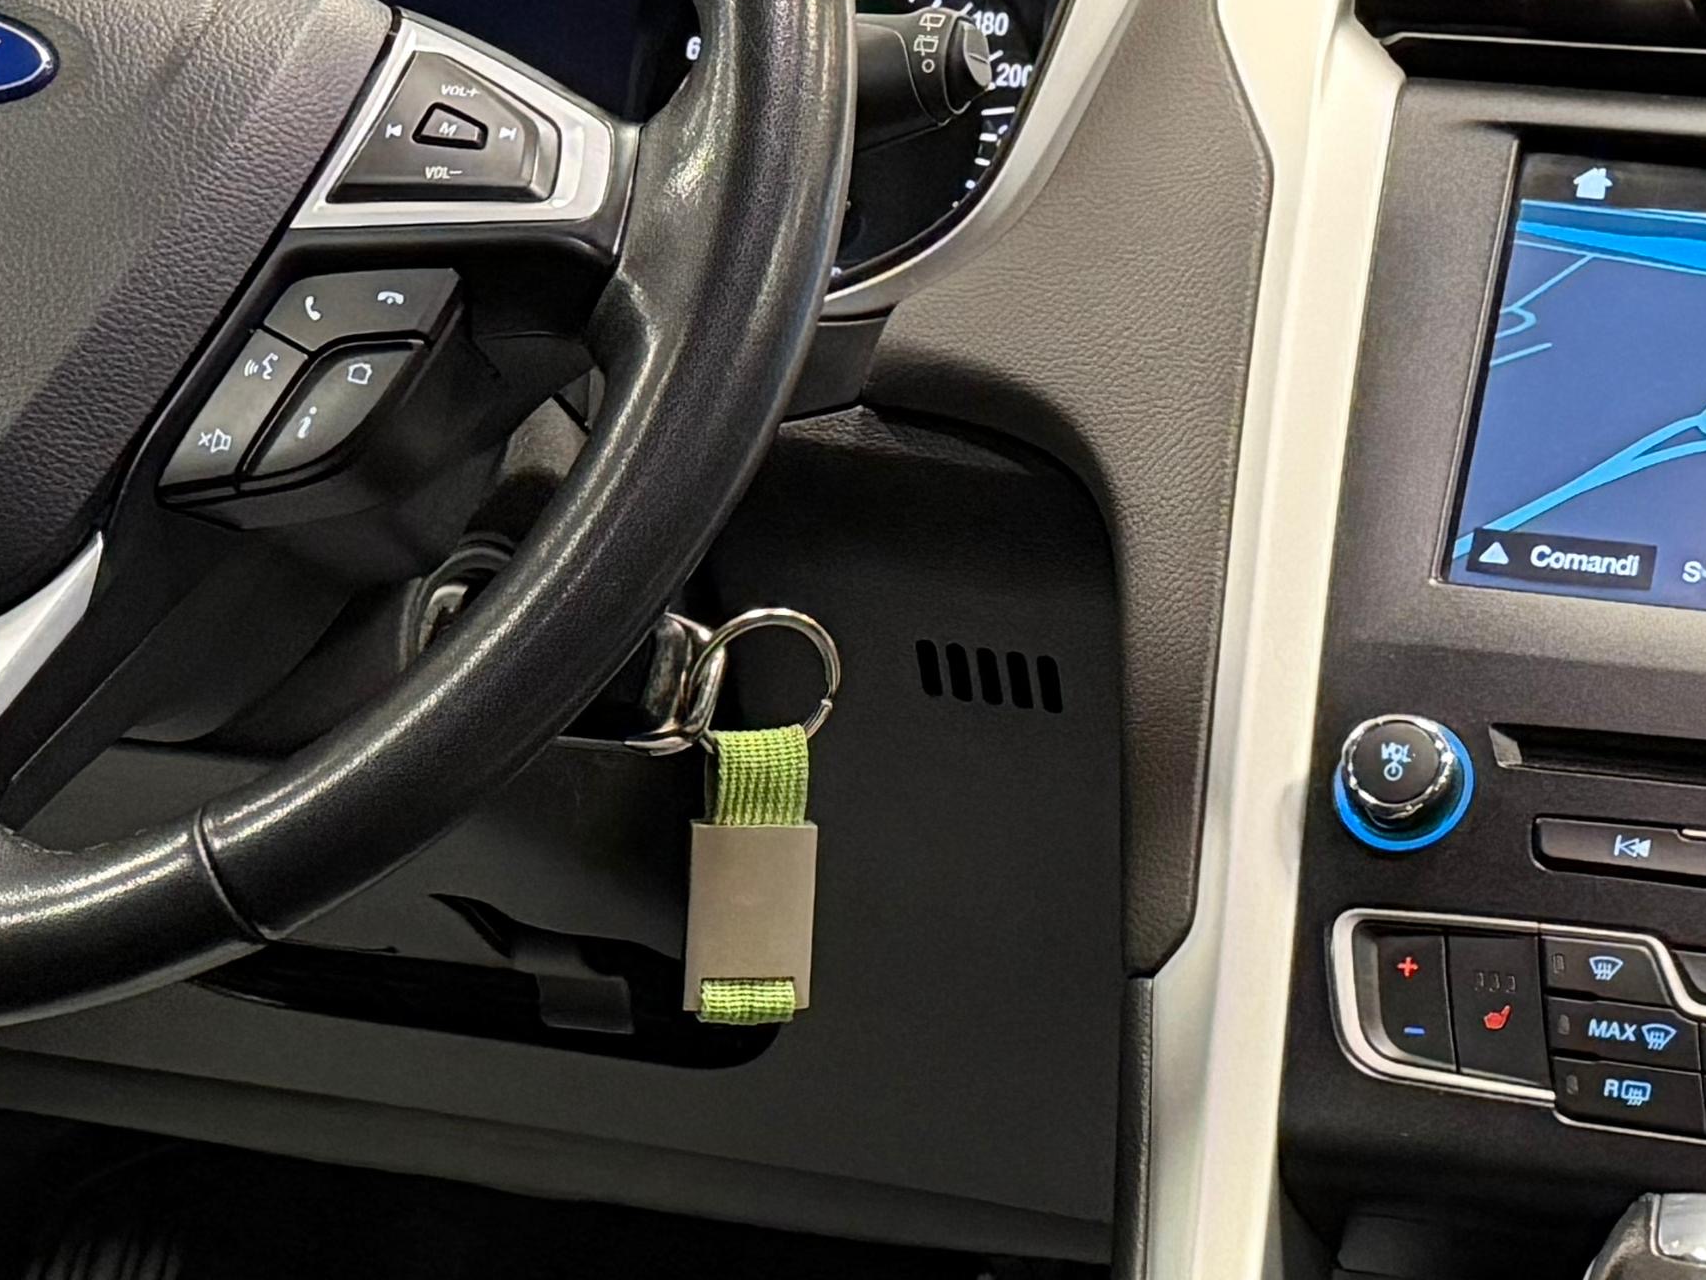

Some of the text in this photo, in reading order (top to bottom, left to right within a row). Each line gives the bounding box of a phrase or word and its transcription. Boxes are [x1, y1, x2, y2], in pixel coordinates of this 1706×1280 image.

[974, 11, 1009, 37] 180
[438, 121, 457, 137] M
[1528, 542, 1642, 578] Comandi
[1380, 741, 1413, 763] VOL
[1587, 1018, 1637, 1042] MAX
[1603, 1078, 1619, 1098] R
